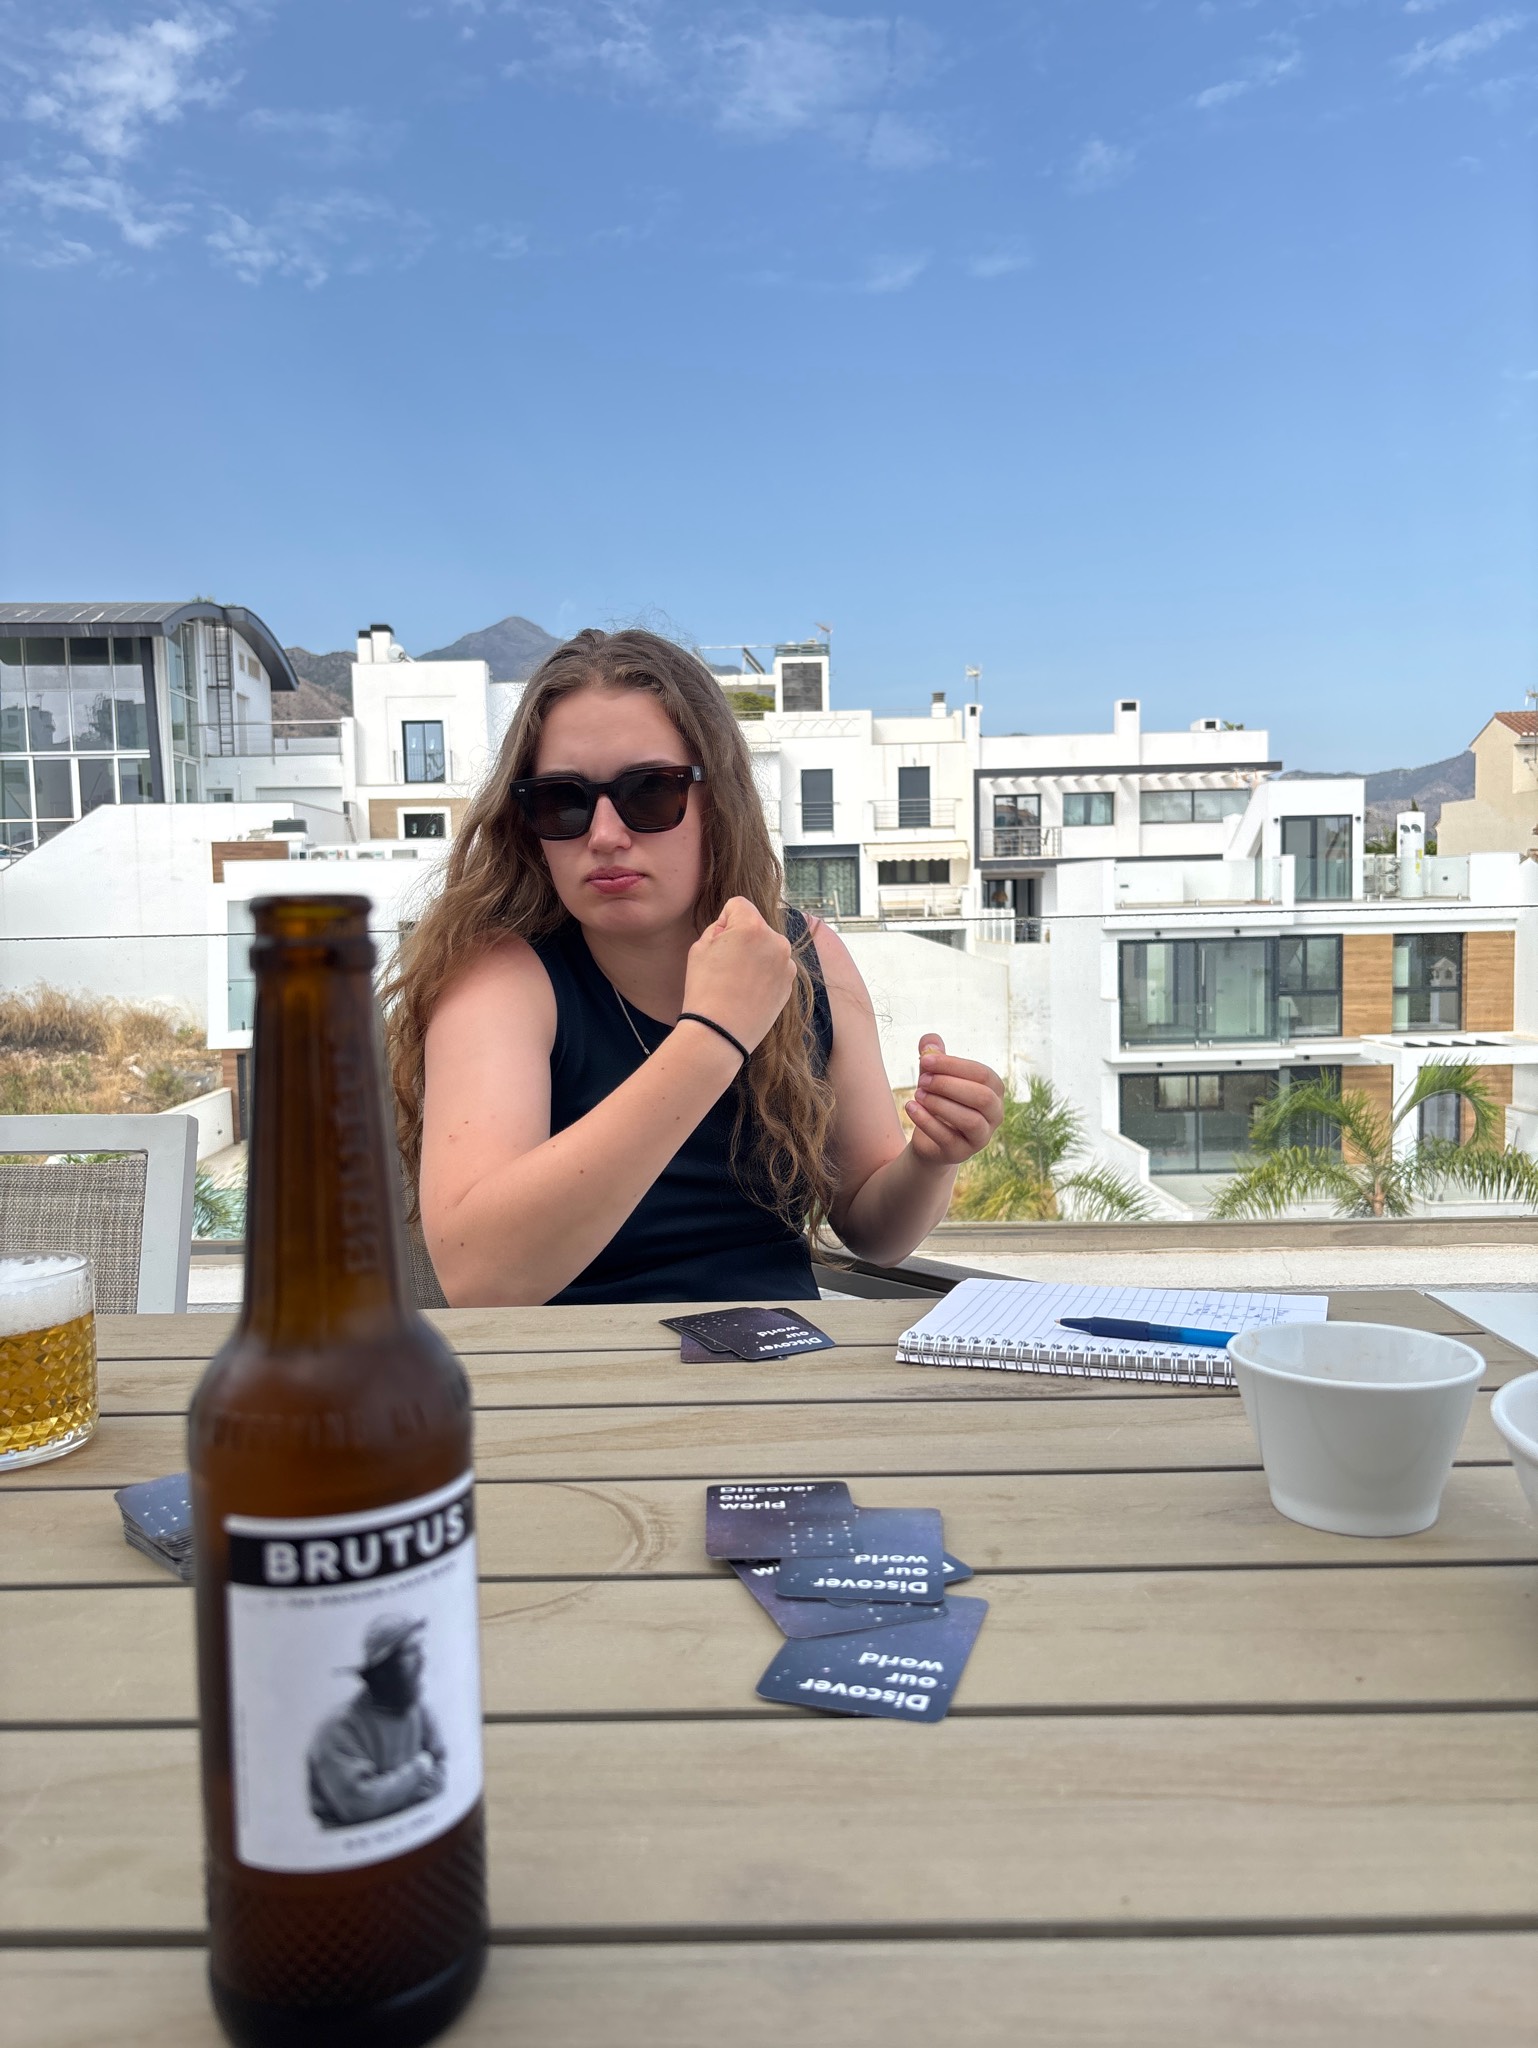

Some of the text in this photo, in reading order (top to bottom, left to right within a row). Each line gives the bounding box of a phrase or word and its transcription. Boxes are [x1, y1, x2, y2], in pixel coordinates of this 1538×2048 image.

[757, 1326, 800, 1337] world
[758, 1337, 822, 1351] Discover
[720, 1486, 815, 1494] Discover
[719, 1500, 785, 1509] world
[263, 1503, 466, 1585] BRUTUS
[854, 1554, 928, 1565] world
[884, 1567, 928, 1576] our
[813, 1577, 928, 1594] Discover
[858, 1651, 944, 1672] world
[885, 1672, 938, 1688] our
[800, 1678, 931, 1711] Discover
